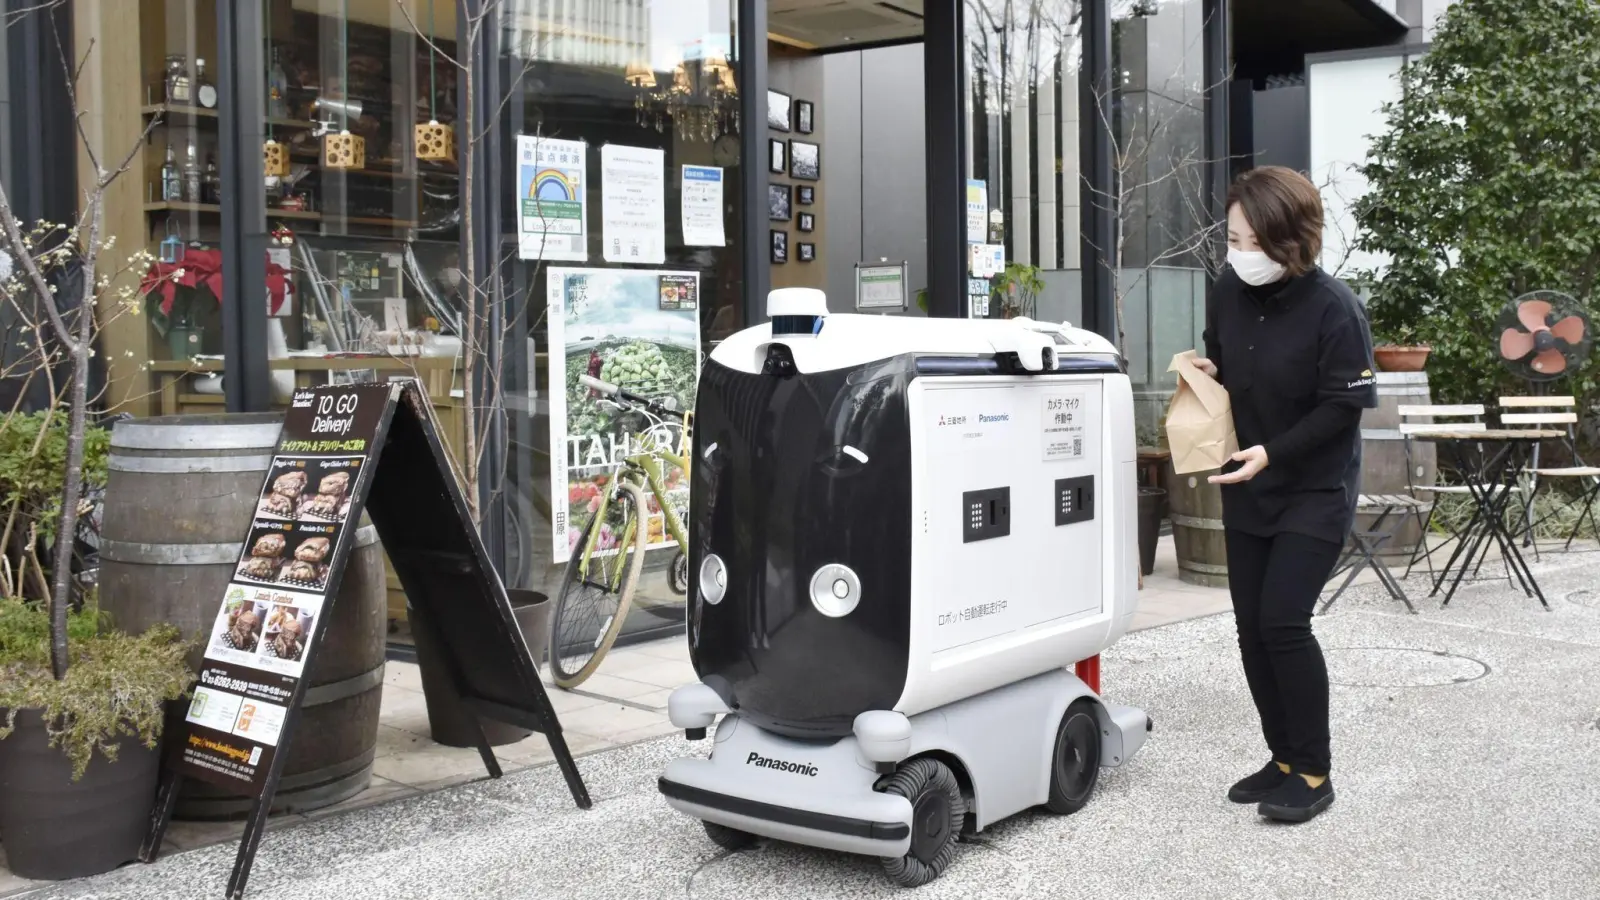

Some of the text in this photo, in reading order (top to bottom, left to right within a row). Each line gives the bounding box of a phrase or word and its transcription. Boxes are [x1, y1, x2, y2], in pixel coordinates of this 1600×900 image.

[317, 394, 358, 415] TO GO
[1047, 398, 1080, 410] カメラ・マイク
[311, 415, 353, 436] Delivery!
[979, 412, 1009, 423] Panasonic
[1054, 412, 1073, 425] 作動中
[556, 511, 565, 535] 田原
[938, 599, 1008, 626] ロボット自動運転走行中
[746, 751, 819, 777] Panasonic
